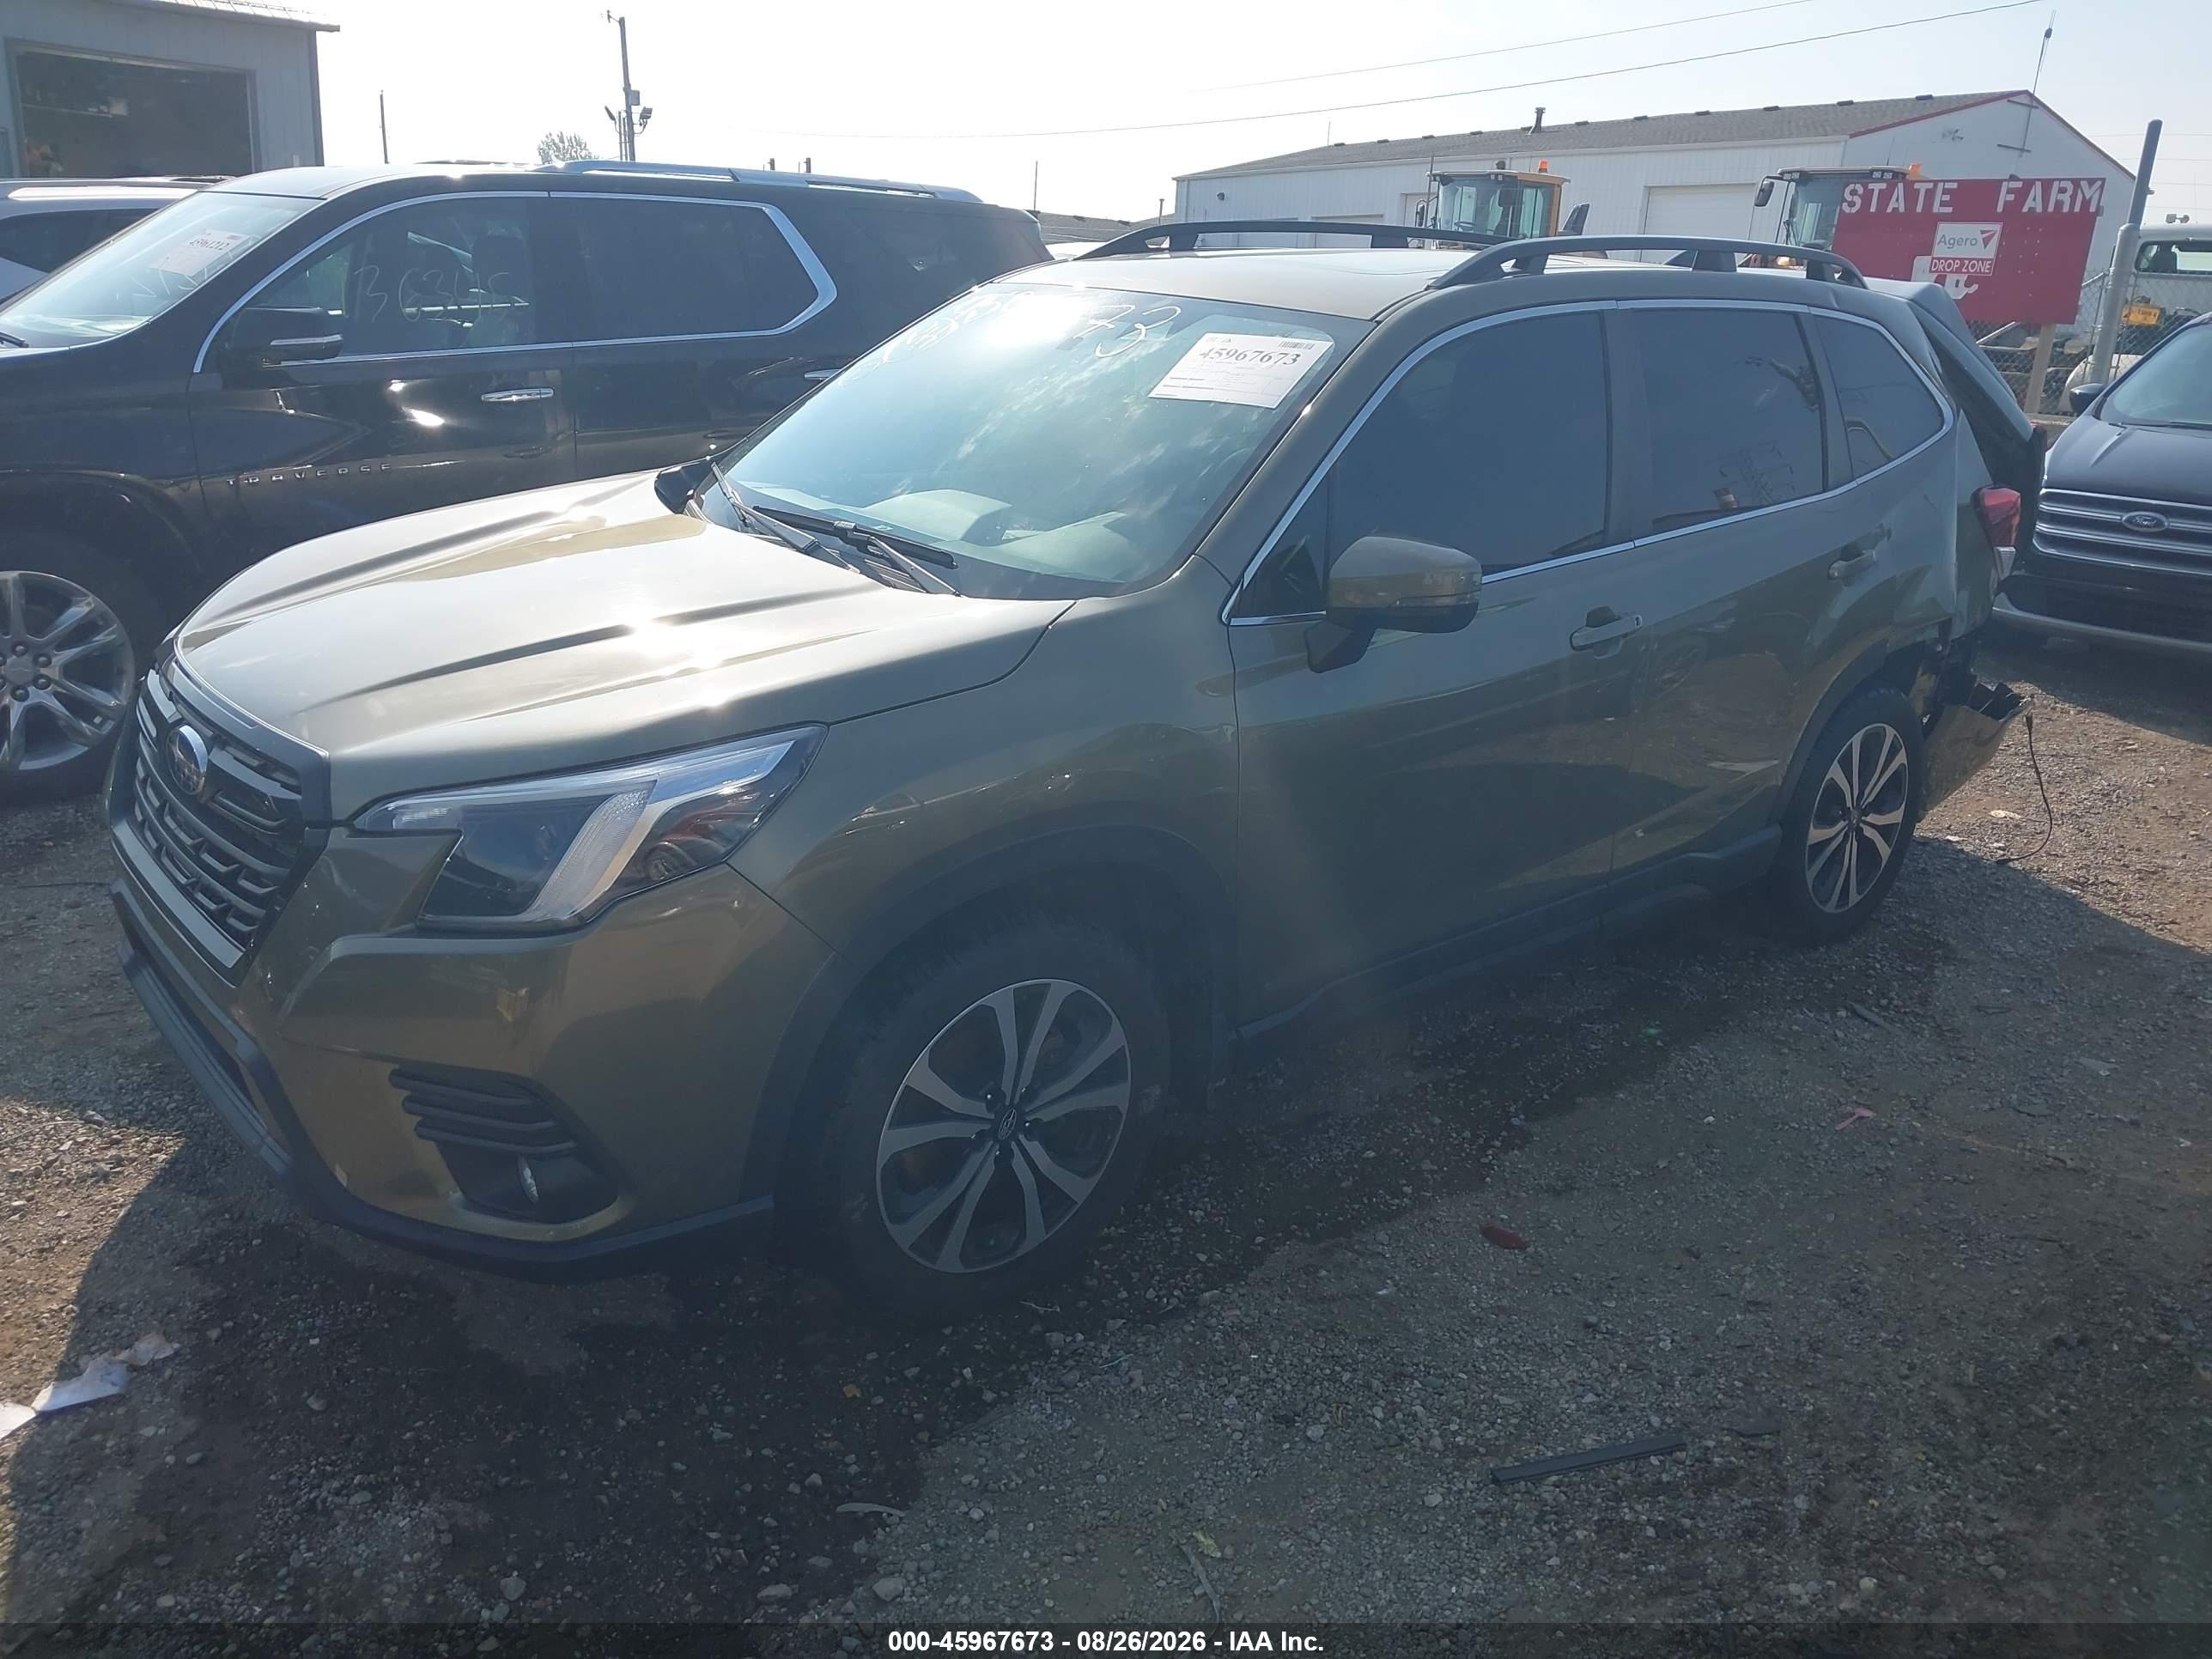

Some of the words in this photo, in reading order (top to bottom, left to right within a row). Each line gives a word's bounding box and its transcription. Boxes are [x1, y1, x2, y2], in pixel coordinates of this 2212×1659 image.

[1842, 181, 1958, 213] STATE
[1996, 179, 2103, 213] FARM
[1937, 233, 1978, 248] Agero
[1931, 258, 1961, 272] DROP
[1961, 259, 1992, 273] ZONE
[1199, 347, 1301, 366] 45967673
[226, 464, 393, 485] TRAVERSE
